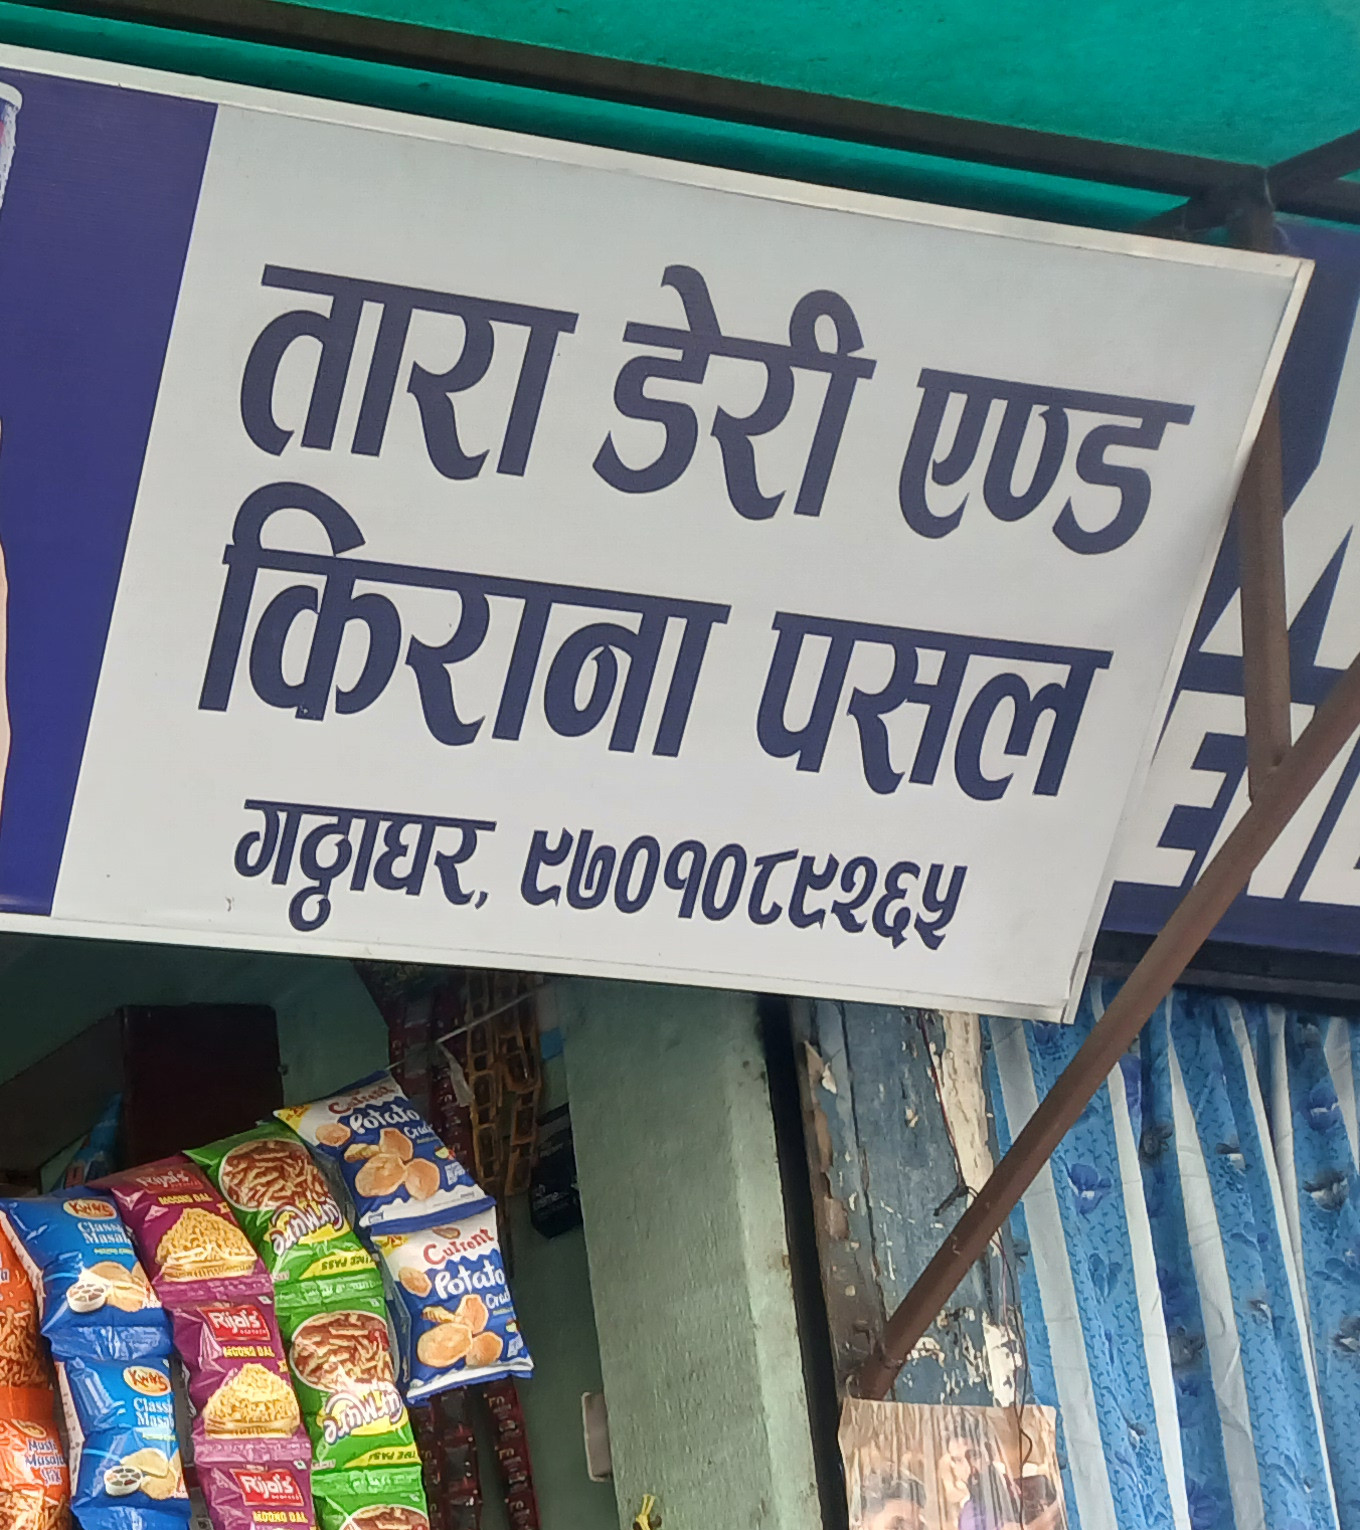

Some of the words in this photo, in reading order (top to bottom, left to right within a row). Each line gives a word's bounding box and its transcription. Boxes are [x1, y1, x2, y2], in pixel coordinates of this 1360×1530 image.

[239, 264, 578, 480] तारा
[592, 264, 877, 520] डेरी
[898, 368, 1194, 555] एण्ड
[197, 481, 732, 757] किराना
[756, 611, 1114, 800] पसल
[348, 1102, 421, 1132] Potato
[422, 1227, 496, 1264] Current
[433, 1259, 507, 1301] Potato
[210, 1309, 260, 1332] Rijal's
[240, 1472, 293, 1496] Rijal's
